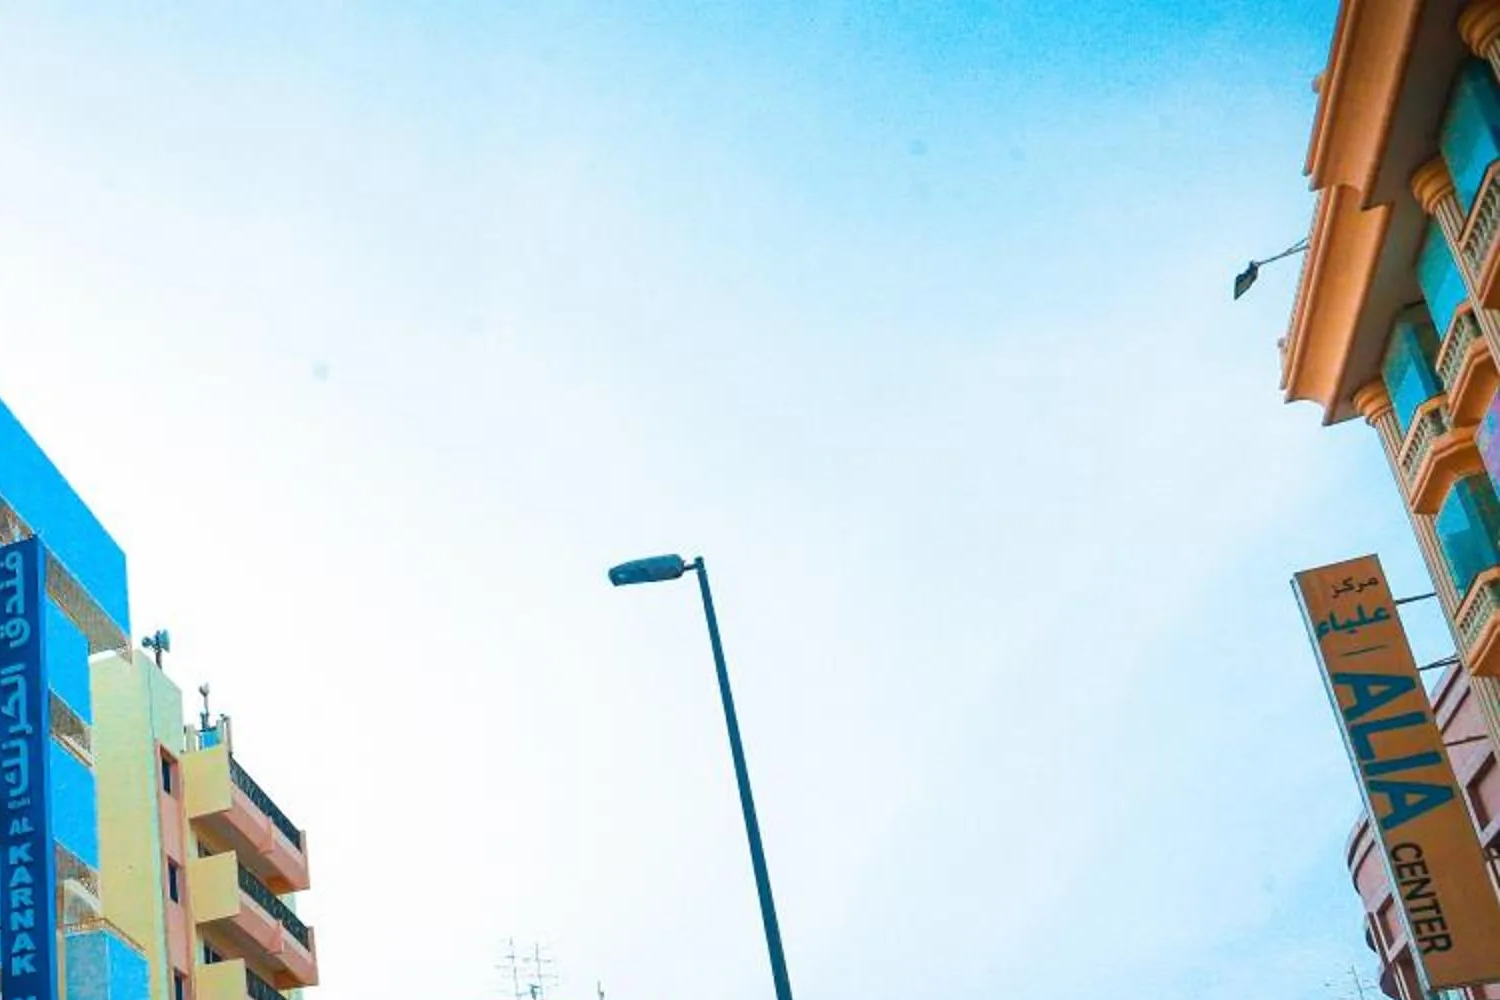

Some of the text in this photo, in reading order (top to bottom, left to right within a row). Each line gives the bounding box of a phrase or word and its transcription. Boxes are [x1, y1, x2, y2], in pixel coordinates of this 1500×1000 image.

[1317, 603, 1390, 641] علياء
[1332, 577, 1379, 598] مركز
[1331, 671, 1456, 830] ALIA
[9, 842, 36, 977] KARNAK
[1391, 842, 1452, 955] CENTER
